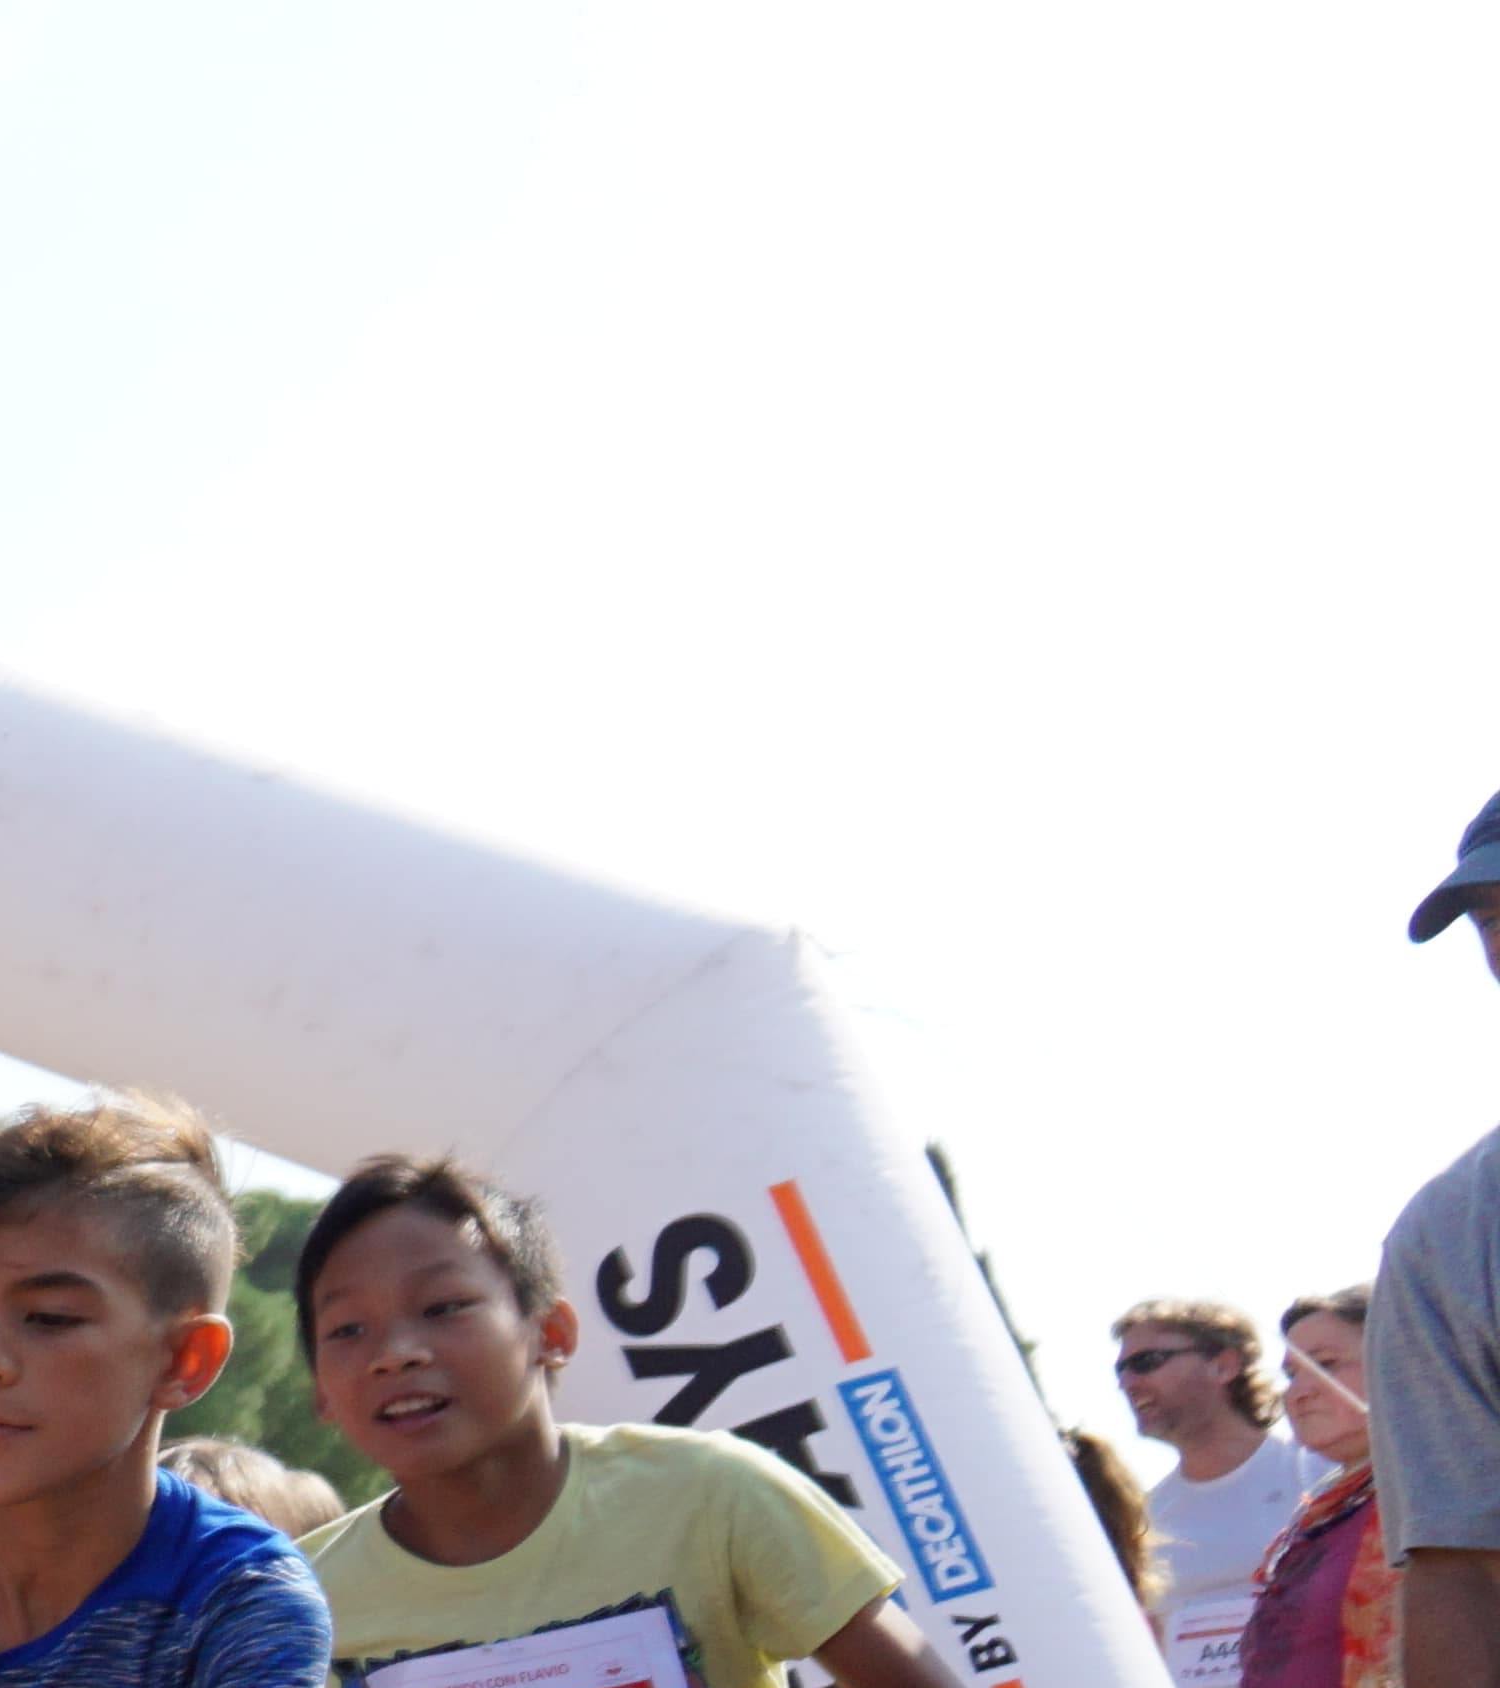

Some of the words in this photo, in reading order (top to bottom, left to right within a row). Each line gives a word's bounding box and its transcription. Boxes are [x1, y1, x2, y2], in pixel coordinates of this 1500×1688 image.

[854, 1379, 984, 1592] DECATHLON
[519, 1663, 570, 1683] FLAVIO
[952, 1613, 1019, 1674] BY
